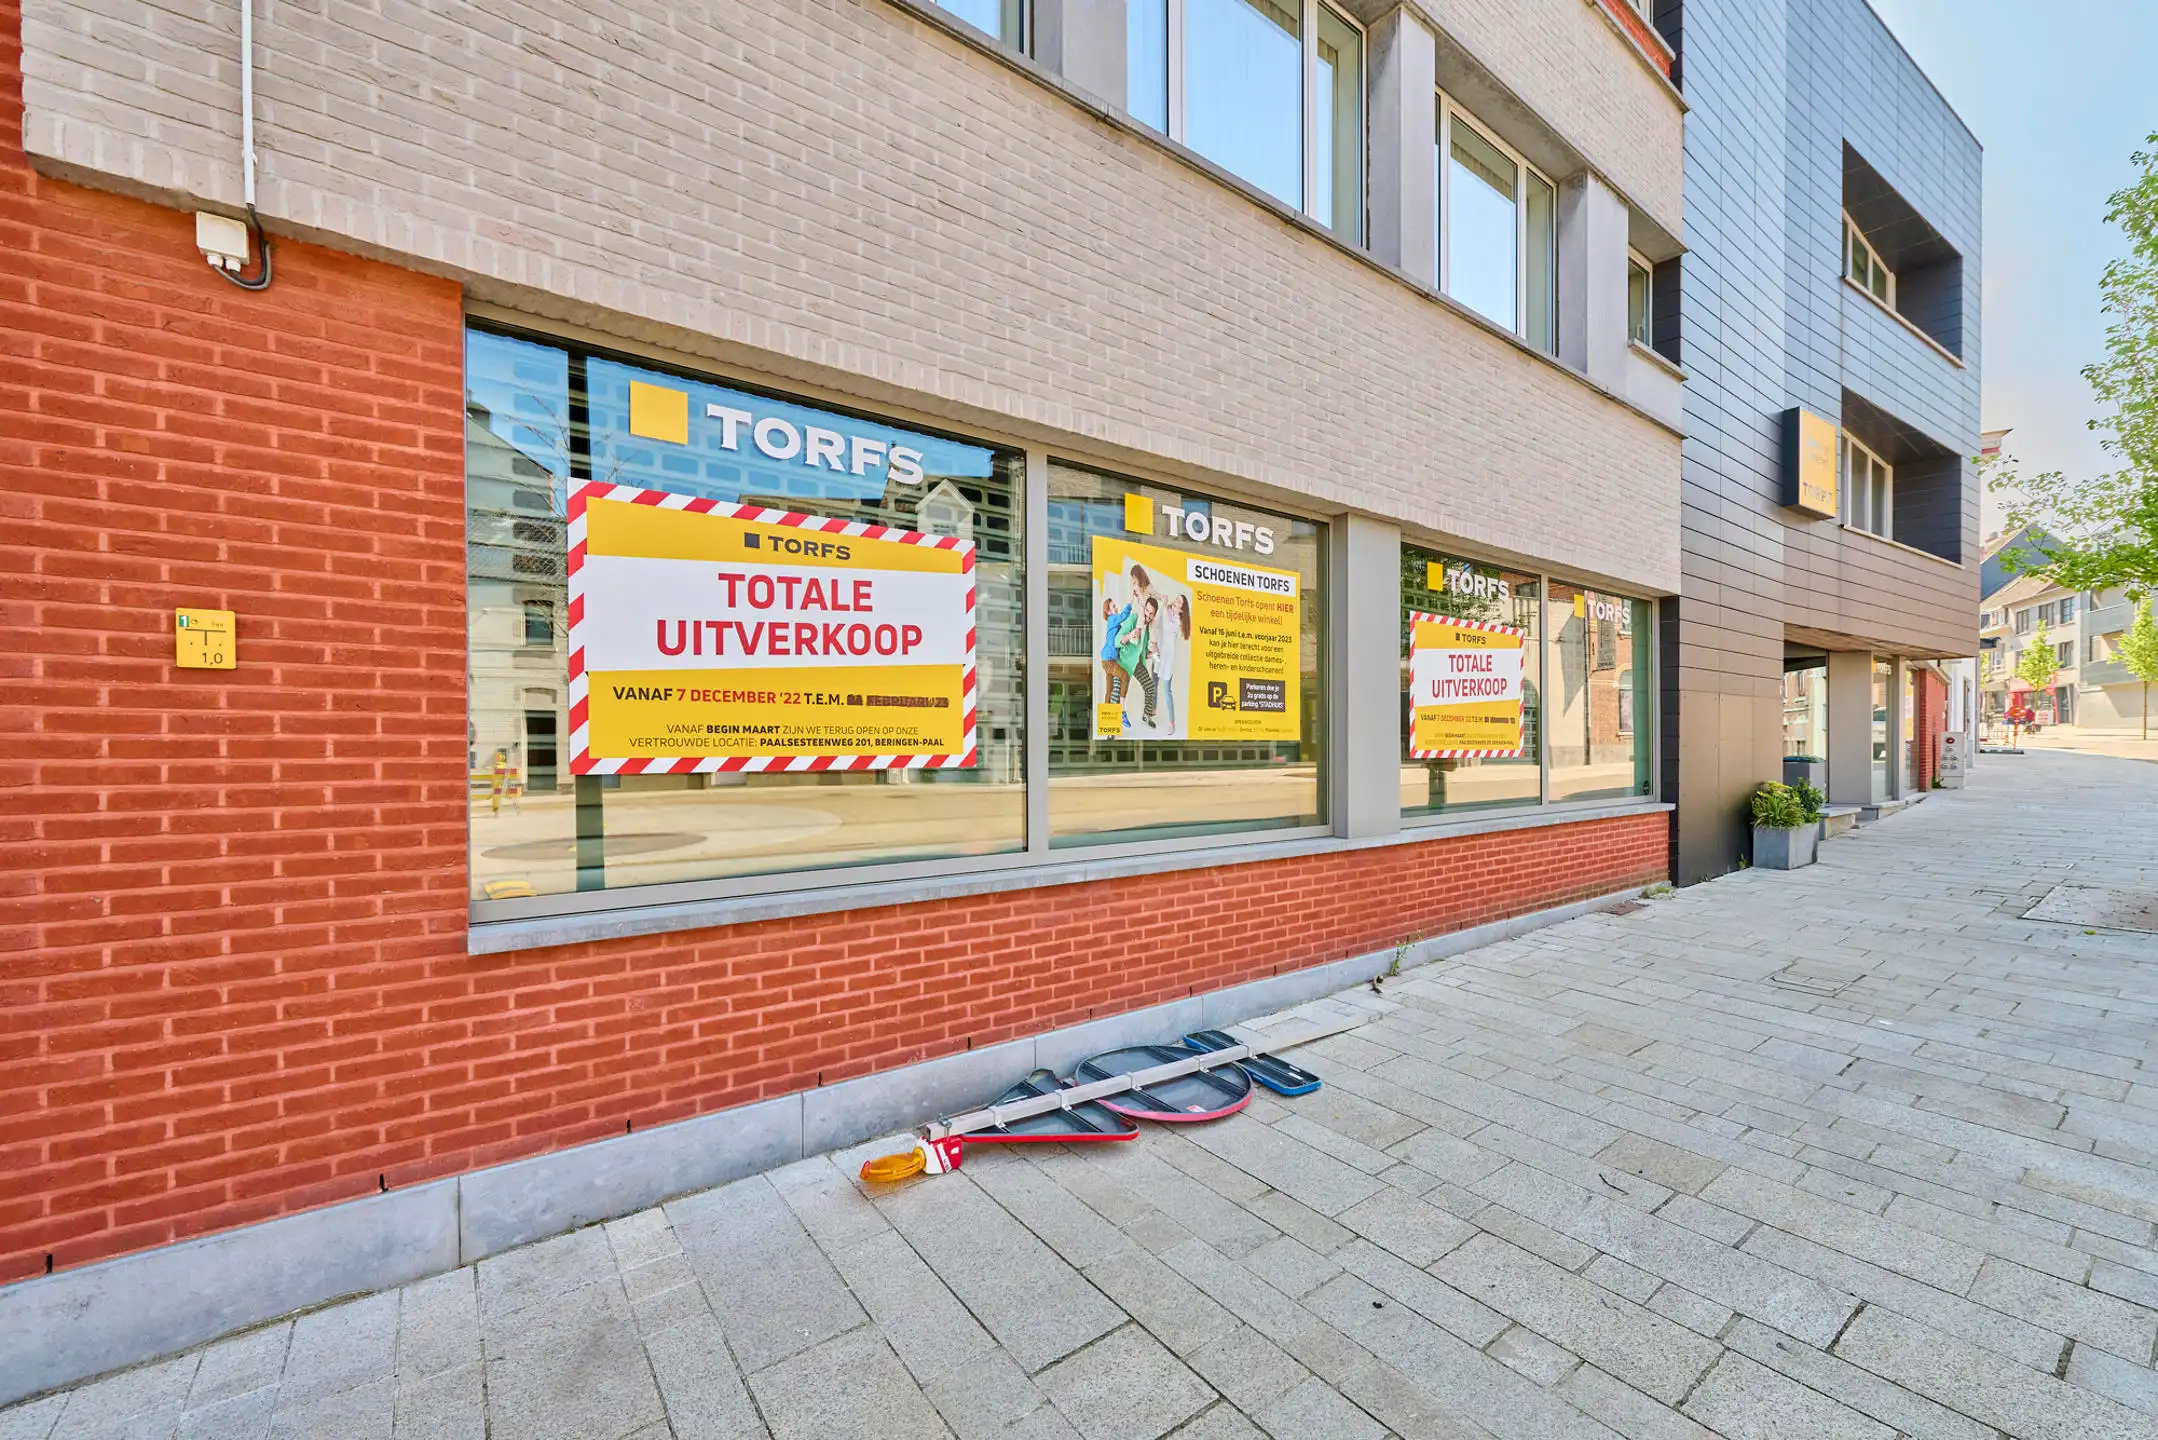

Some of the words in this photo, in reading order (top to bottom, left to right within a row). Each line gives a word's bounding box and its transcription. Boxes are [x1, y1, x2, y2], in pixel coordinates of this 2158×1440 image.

[707, 403, 924, 485] TORFS
[1161, 504, 1275, 555] TORFS
[768, 536, 851, 561] TORFS
[1194, 565, 1255, 587] SCHOENEN
[1256, 575, 1290, 593] TORFS
[1446, 568, 1510, 602] TORFS
[718, 573, 873, 613] TOTALE
[1197, 590, 1236, 605] Schoenen
[1236, 596, 1255, 609] Torfs
[1255, 601, 1276, 612] opent
[1276, 602, 1295, 613] HIER
[1210, 609, 1225, 618] een
[1226, 609, 1257, 623] tijdelijke
[1587, 600, 1630, 625] TORFS
[657, 619, 923, 656] UITVERKOOP
[1199, 626, 1218, 636] Vanaf
[1225, 628, 1237, 639] juni
[1254, 633, 1277, 643] voorjaar
[1278, 635, 1292, 643] 2023
[1461, 633, 1487, 645] TORFS
[1448, 653, 1493, 673] TOTALE
[612, 686, 673, 701] VANAF
[676, 688, 686, 701] 7
[690, 689, 776, 704] DECEMBER
[779, 692, 801, 705] '22
[803, 693, 845, 706] T.E.M.
[1213, 687, 1223, 704] P
[1431, 677, 1508, 698] UITVERKOOP
[667, 724, 704, 734] VANAF
[706, 724, 740, 734] BEGIN
[742, 725, 781, 734] MAART
[782, 725, 804, 735] ZIJN
[805, 725, 822, 735] WE
[824, 726, 854, 735] TERUG
[855, 726, 881, 735] OPEN
[881, 727, 893, 735] OP
[895, 727, 919, 735] ONZE
[629, 737, 710, 747] VERTROUWDE
[712, 737, 757, 747] LOCATIE:
[760, 738, 853, 747] PAALSESTEENWEG
[855, 738, 873, 747] 201,
[875, 738, 944, 747] BERINGEN-PAAL
